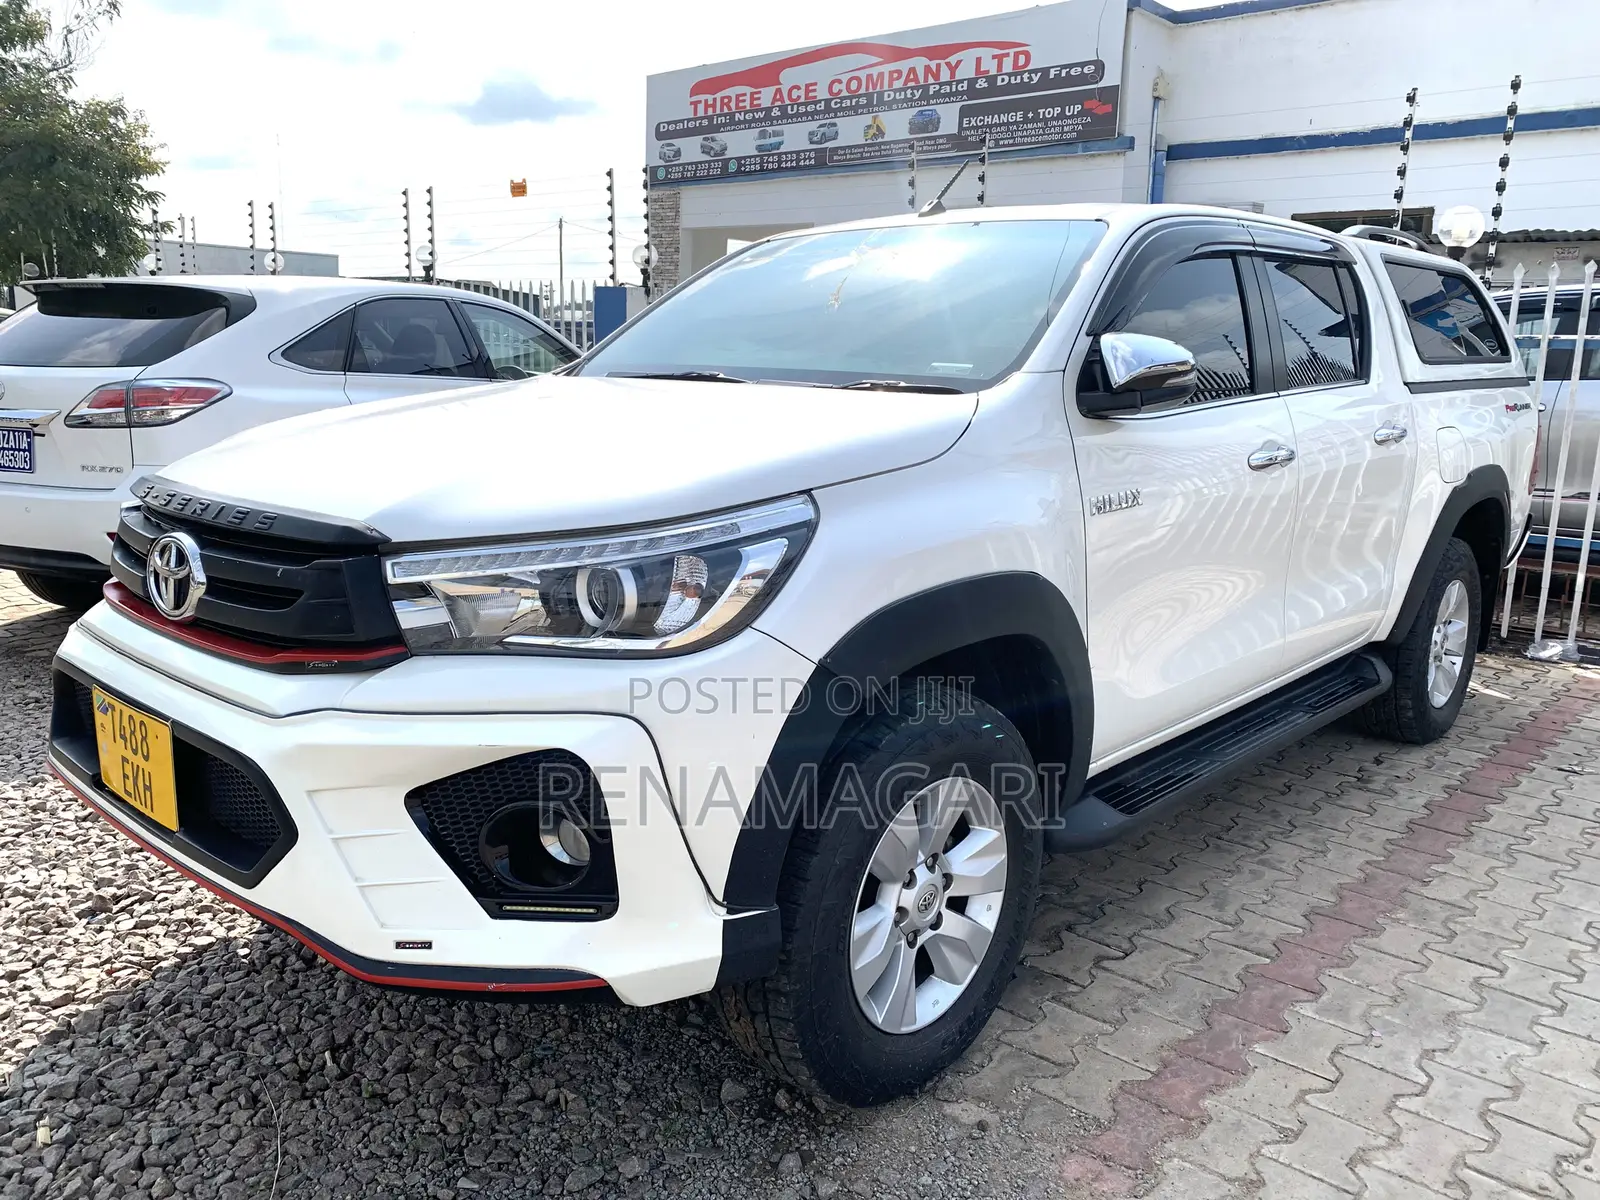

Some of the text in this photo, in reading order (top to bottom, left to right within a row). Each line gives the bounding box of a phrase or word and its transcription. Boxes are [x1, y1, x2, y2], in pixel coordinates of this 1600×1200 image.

[689, 49, 1032, 117] THREE ACE COMPANY LTD
[660, 118, 709, 132] Dealers
[713, 114, 730, 125] in:
[735, 110, 766, 122] New
[771, 106, 782, 117] &
[787, 100, 825, 115] Used
[830, 96, 868, 109] Cars
[884, 87, 923, 102] Duty
[929, 80, 968, 95] Paid
[975, 77, 989, 89] &
[997, 71, 1042, 86] Duty
[1049, 64, 1096, 79] Free
[720, 123, 750, 132] AIRPORT
[751, 121, 771, 129] ROAD
[773, 115, 812, 126] SABASABA
[814, 112, 835, 120] NEAR
[858, 105, 889, 114] PETROL
[892, 100, 928, 109] STATION
[929, 94, 969, 104] MWANZA
[963, 104, 1082, 128] EXCHANGE + TOP UP
[991, 125, 1008, 133] GARI
[1047, 116, 1092, 127] UNAONGEZA
[999, 132, 1077, 146] www.threeacemotor.com
[1013, 128, 1044, 138] UNAPATA
[1045, 126, 1063, 135] GARI
[1064, 123, 1083, 133] MPYA
[740, 151, 816, 165] +255 745 333 376
[740, 158, 815, 172] +255 780 444 444
[696, 169, 708, 177] 222
[1089, 487, 1143, 517] HILUX
[107, 701, 150, 762] T488
[121, 755, 154, 814] EKH
